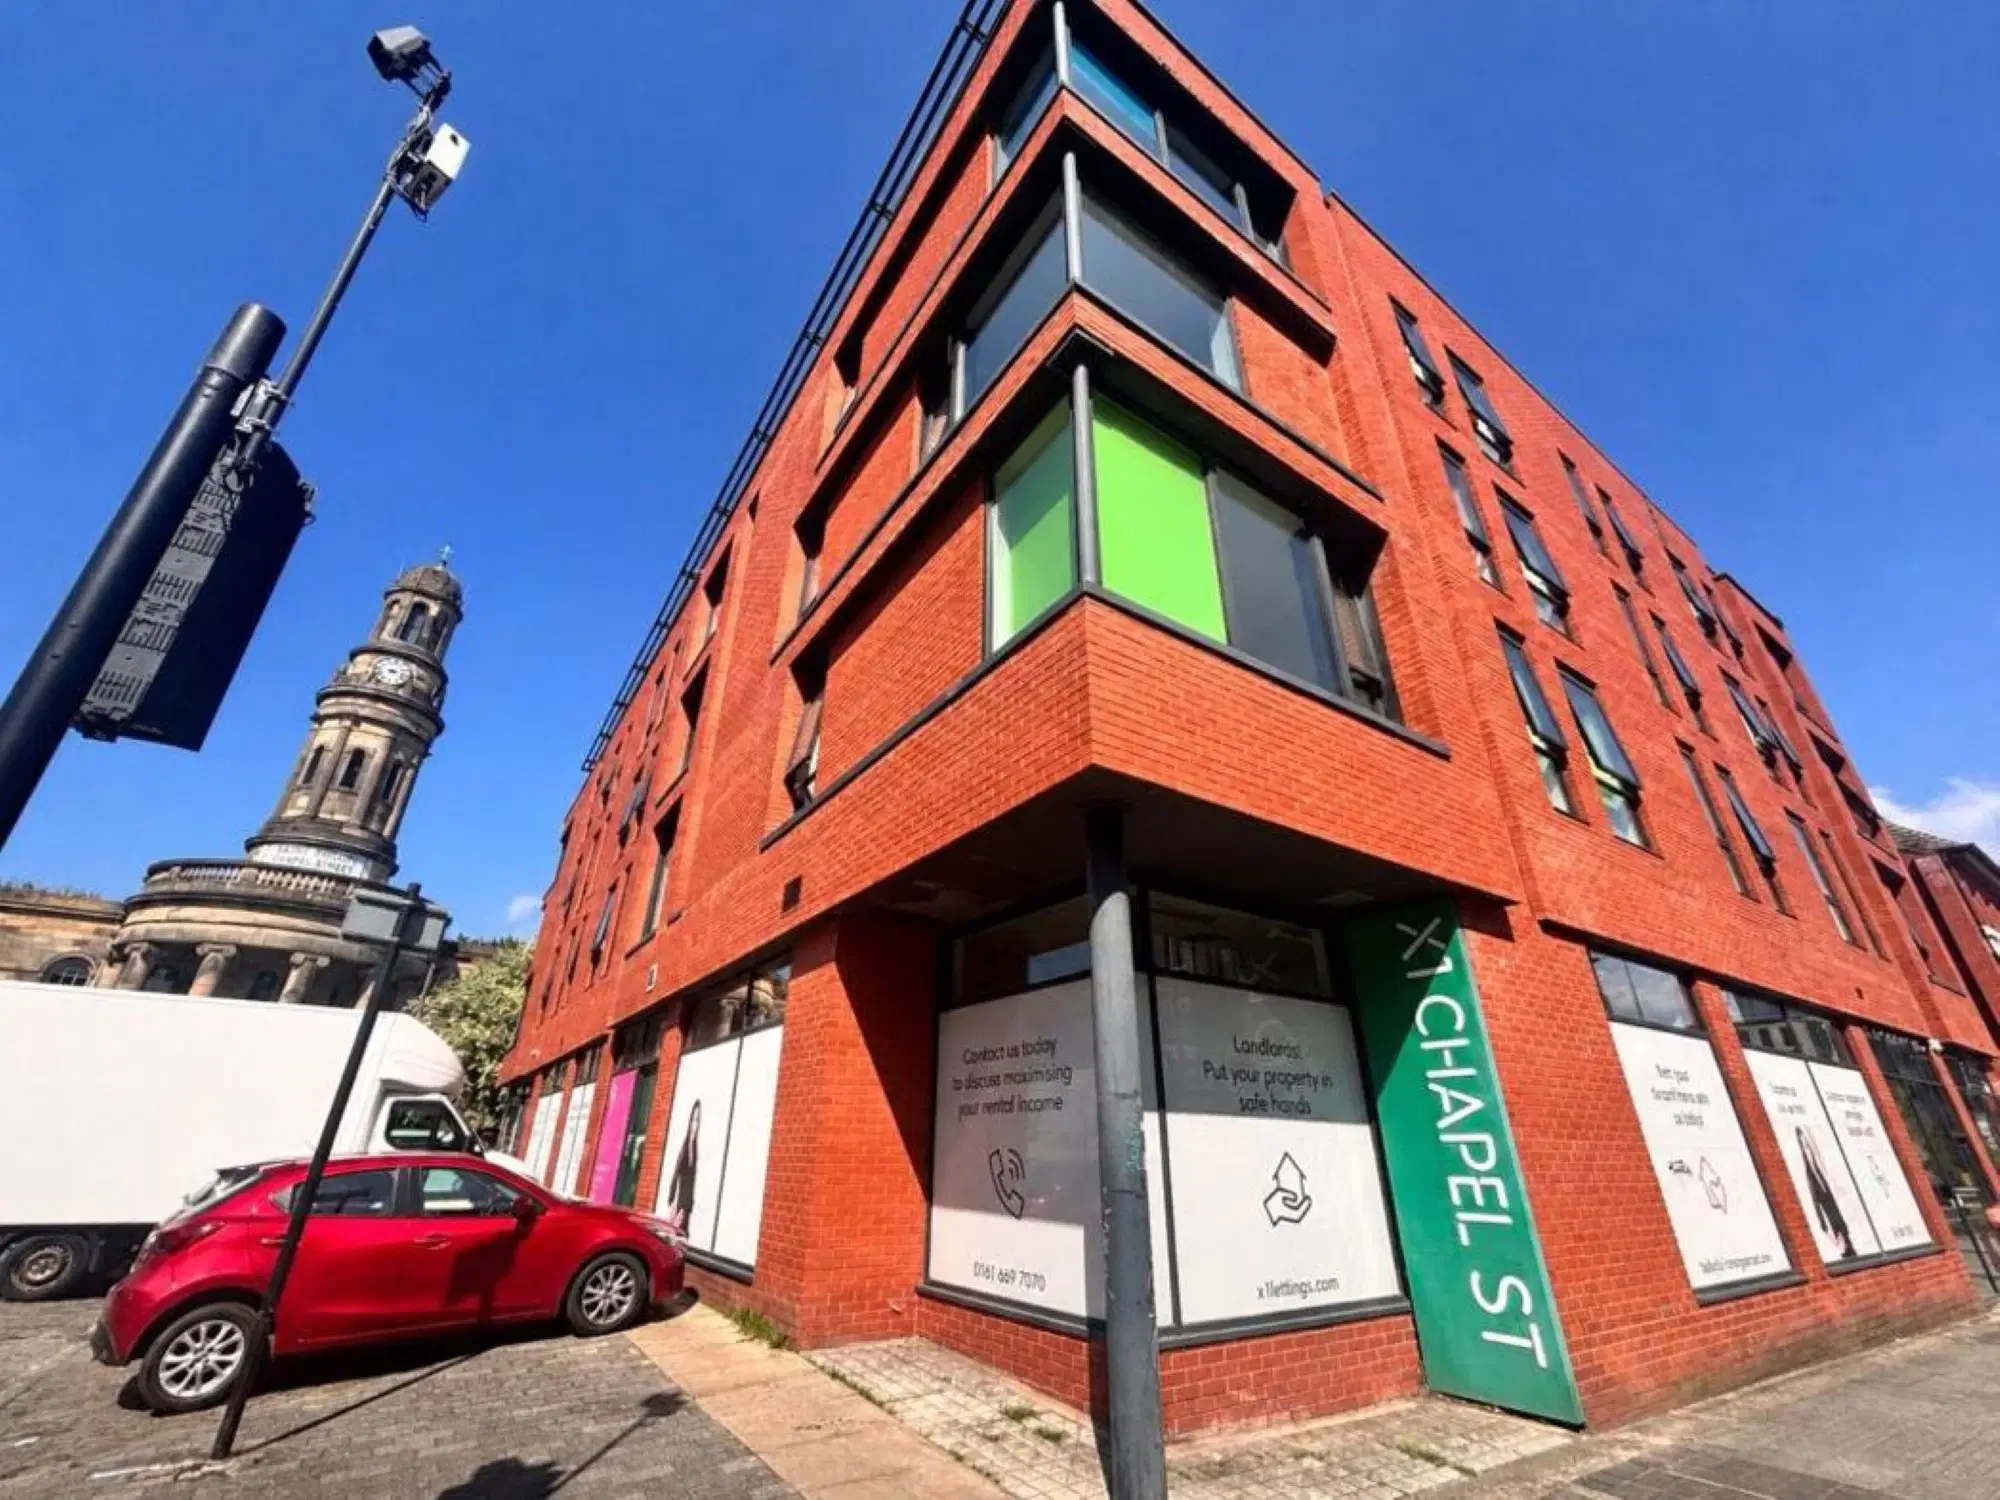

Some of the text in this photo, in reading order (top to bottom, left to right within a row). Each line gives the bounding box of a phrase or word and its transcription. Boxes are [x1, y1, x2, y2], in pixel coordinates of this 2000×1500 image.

[962, 1036, 1057, 1065] Contact us today
[1203, 1059, 1229, 1081] Put
[1231, 1068, 1260, 1087] your
[1262, 1070, 1318, 1094] property
[957, 1093, 1063, 1123] your rental income
[1239, 1092, 1312, 1115] safe hands
[1395, 917, 1548, 1368] X1 CHAPEL ST
